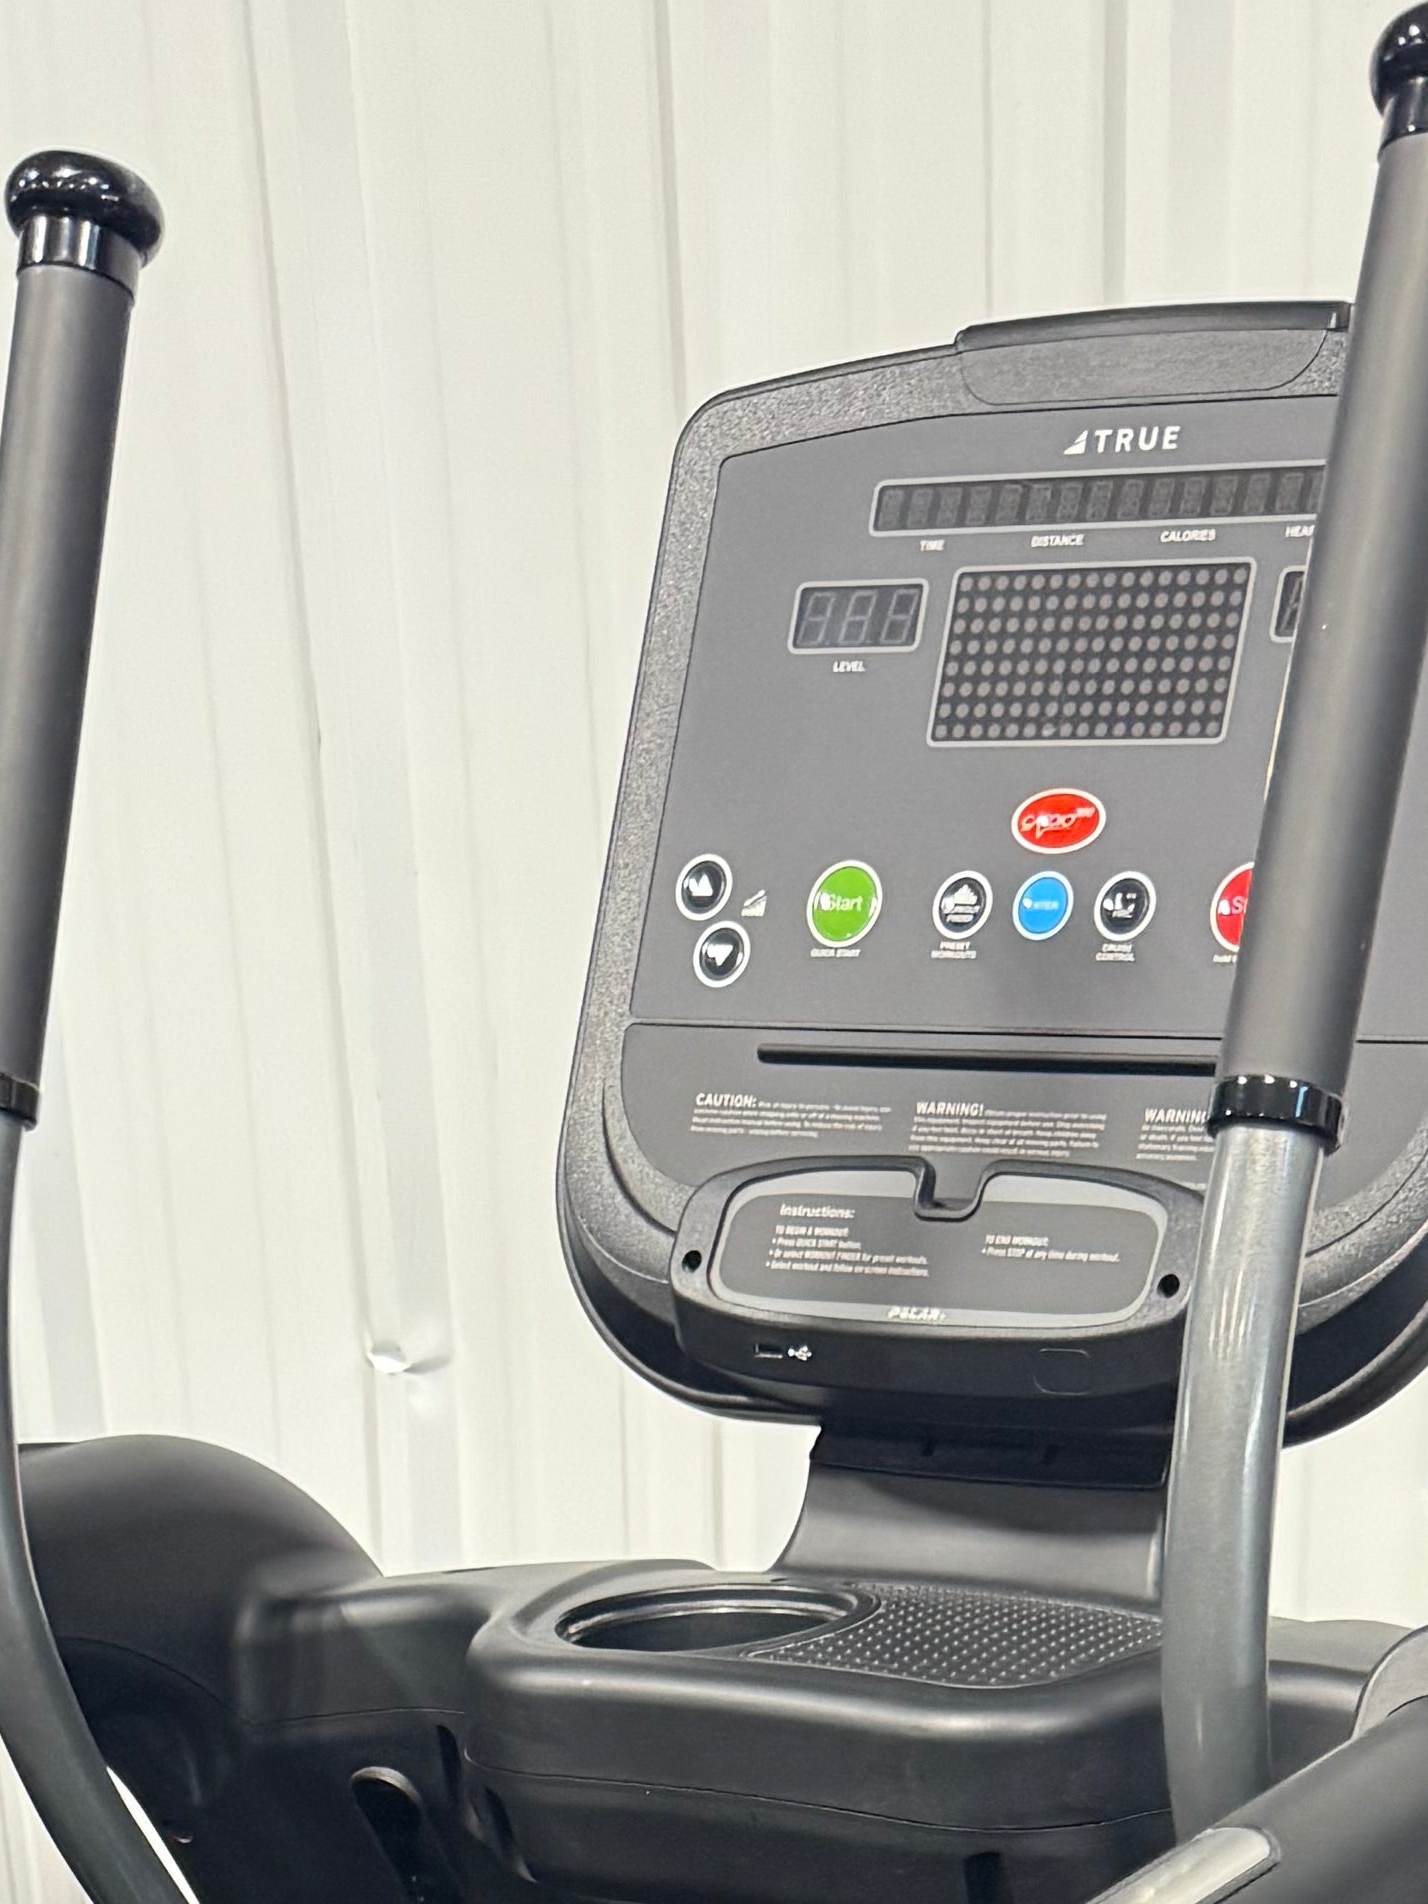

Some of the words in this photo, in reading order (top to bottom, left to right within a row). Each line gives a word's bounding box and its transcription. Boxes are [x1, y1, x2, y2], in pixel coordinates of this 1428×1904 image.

[1093, 425, 1181, 453] TRUE
[1160, 528, 1217, 543] CALORIES
[695, 1092, 757, 1108] CAUTION:
[916, 1101, 984, 1117] WARNING!
[779, 1203, 856, 1219] Instructions:
